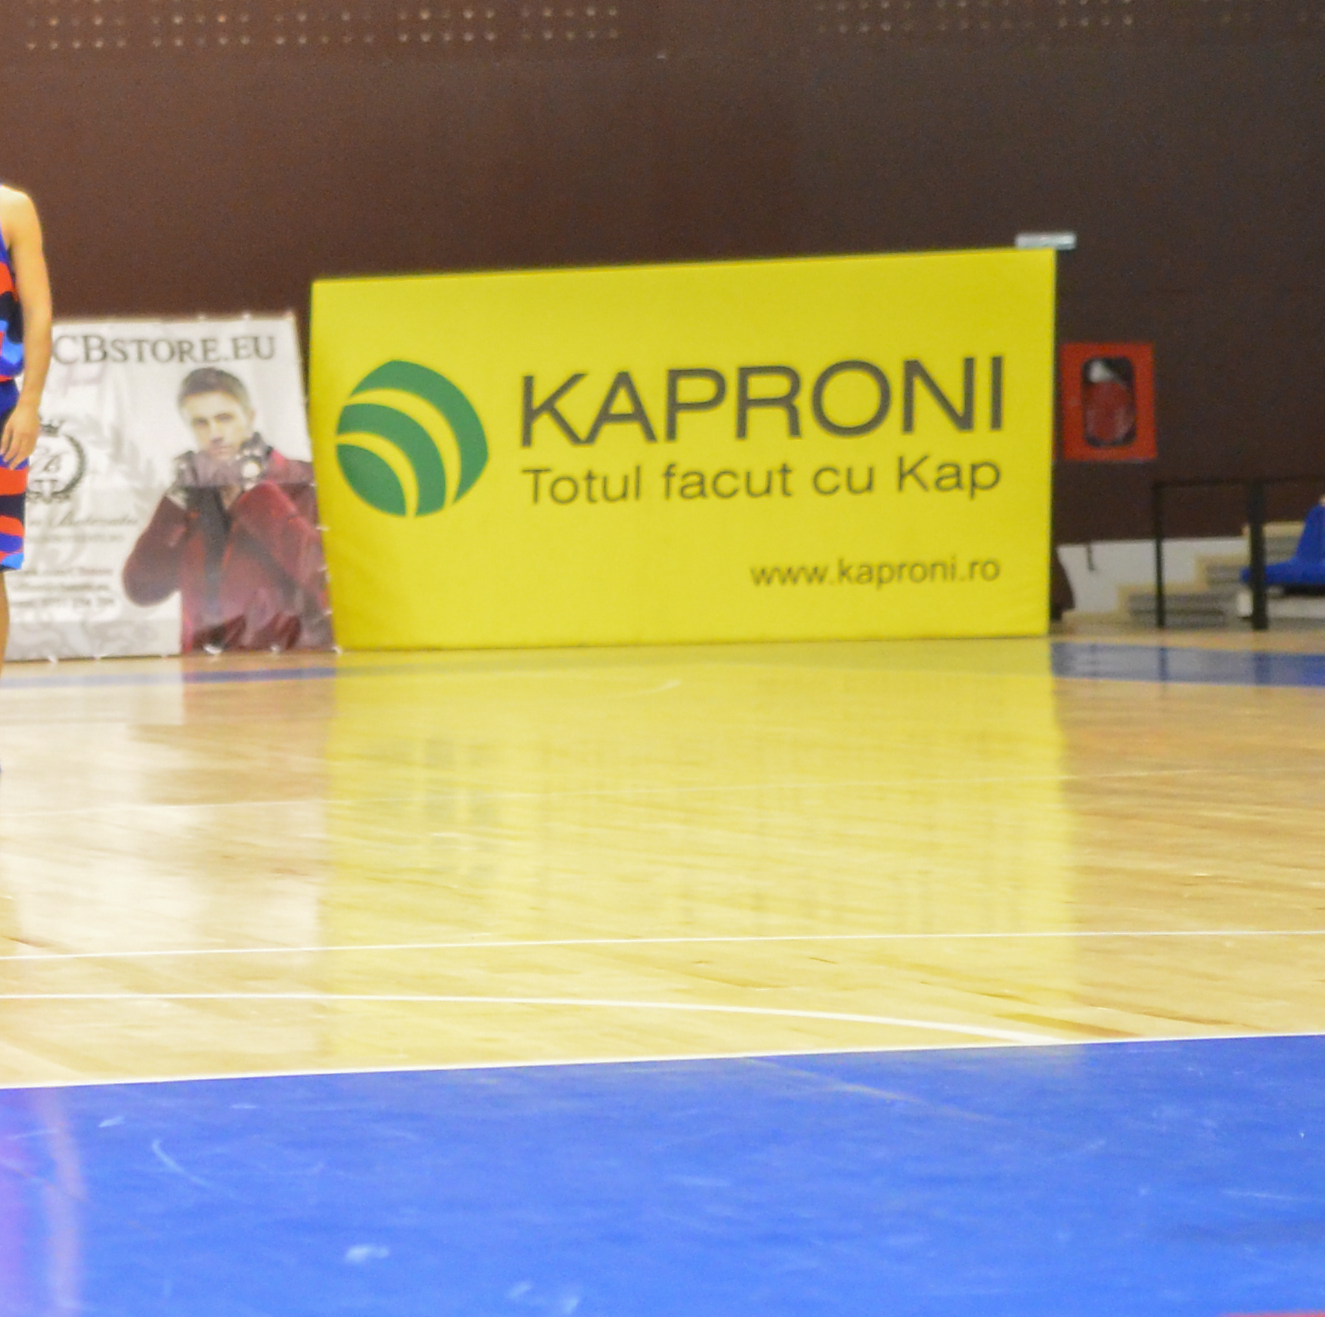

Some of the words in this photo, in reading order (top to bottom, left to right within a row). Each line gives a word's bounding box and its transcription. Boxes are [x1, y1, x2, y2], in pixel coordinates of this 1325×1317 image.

[520, 355, 1004, 448] KAPRONI
[521, 466, 642, 506] Totul
[663, 461, 794, 501] facut
[812, 464, 876, 496] cu
[898, 453, 1002, 501] Kap
[750, 554, 1002, 592] www.kaproni.ro
